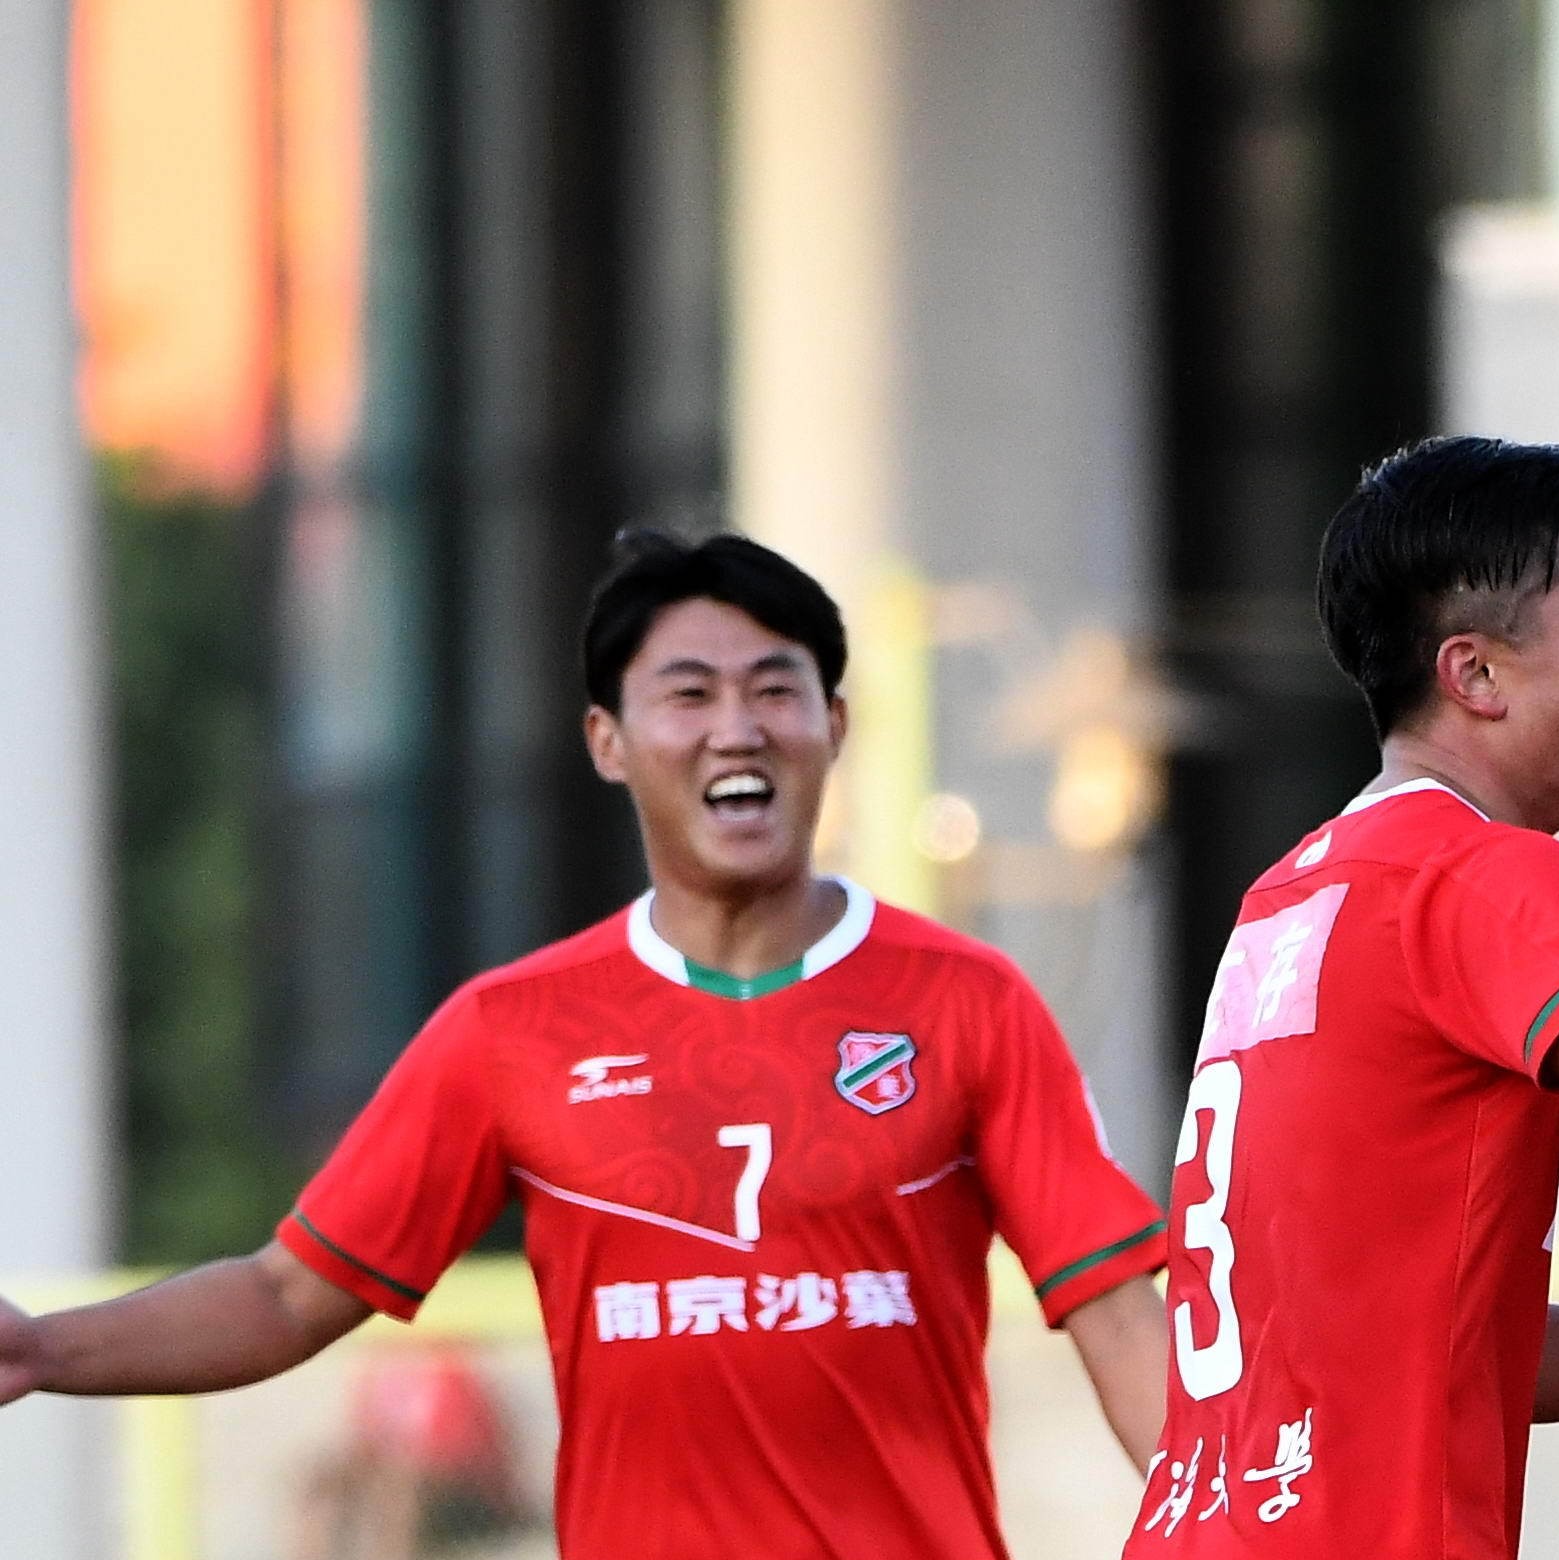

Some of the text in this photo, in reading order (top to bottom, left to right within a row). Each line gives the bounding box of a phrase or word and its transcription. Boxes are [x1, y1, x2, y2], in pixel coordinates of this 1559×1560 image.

[717, 1122, 772, 1241] 7
[1172, 1059, 1244, 1401] 3
[594, 1270, 918, 1342] 南京沙葉
